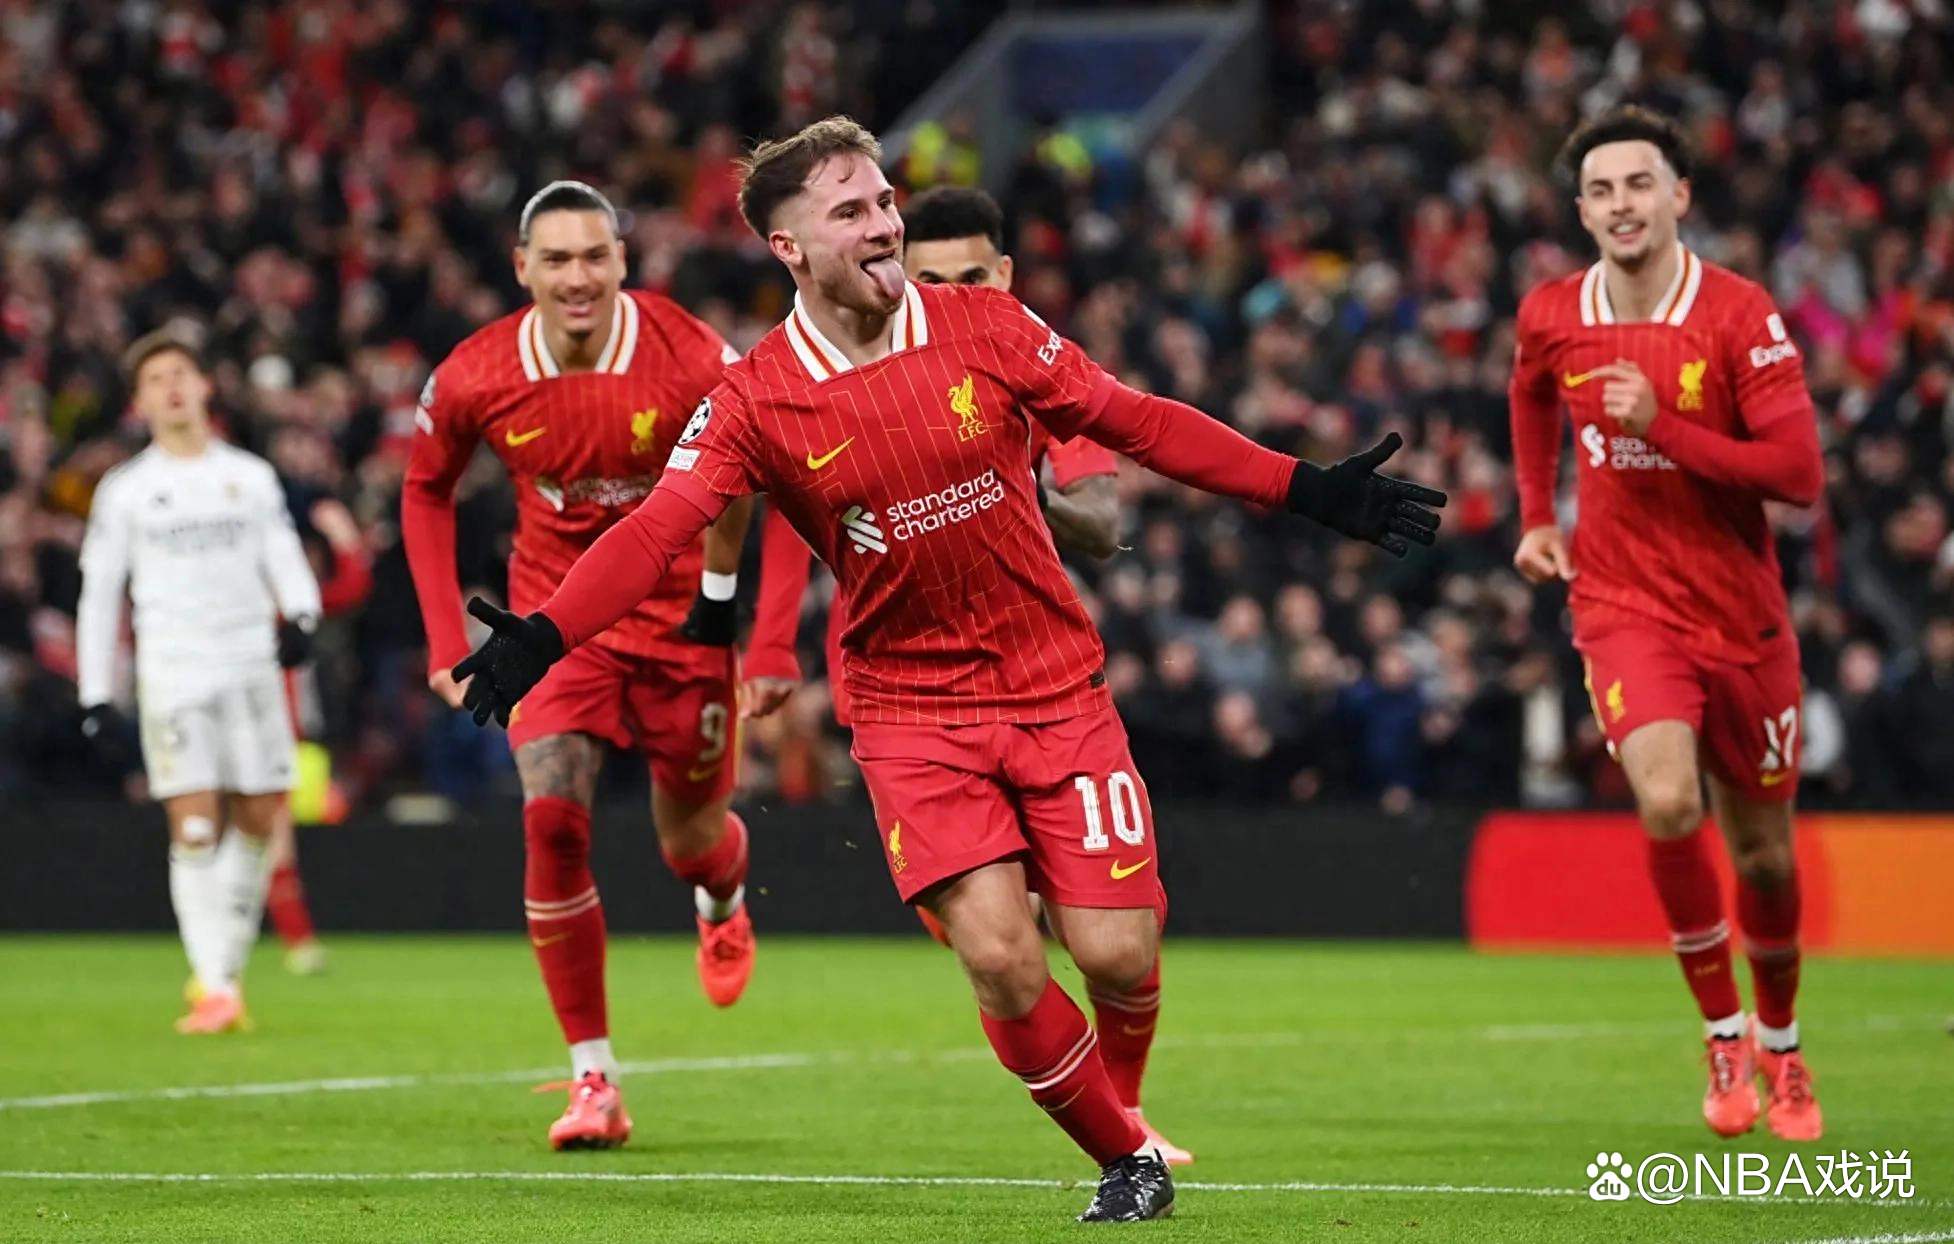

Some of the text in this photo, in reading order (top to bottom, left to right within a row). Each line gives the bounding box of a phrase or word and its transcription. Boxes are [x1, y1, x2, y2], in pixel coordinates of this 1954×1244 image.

[886, 468, 996, 523] standard
[892, 481, 1006, 541] chartered
[700, 702, 727, 761] 9
[1760, 706, 1797, 770] 17
[1074, 771, 1145, 851] 10
